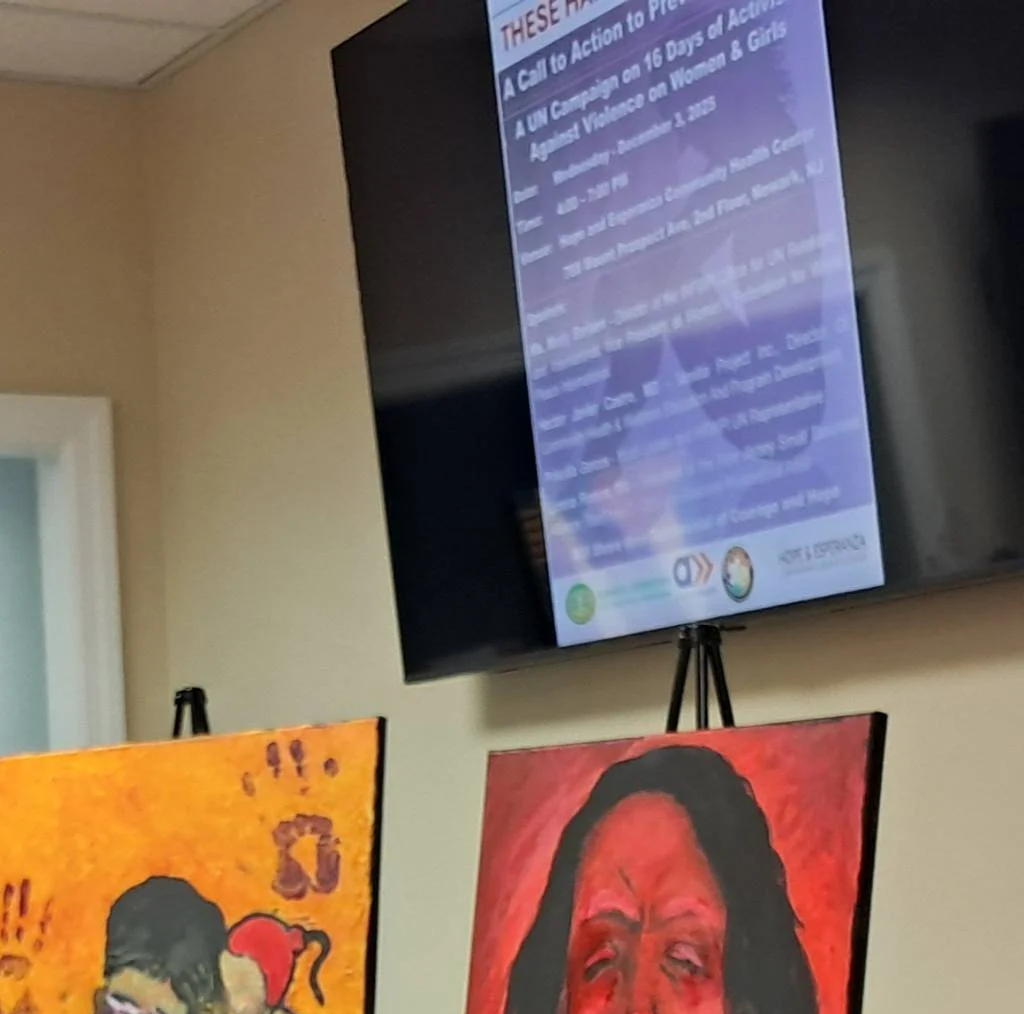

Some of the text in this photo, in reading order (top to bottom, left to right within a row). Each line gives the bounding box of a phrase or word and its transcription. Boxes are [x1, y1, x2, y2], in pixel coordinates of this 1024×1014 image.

[501, 0, 560, 50] THESE
[503, 77, 515, 100] A
[517, 58, 548, 92] Call
[549, 52, 568, 74] to
[571, 22, 623, 64] Action
[626, 10, 645, 33] to
[515, 119, 525, 140] A
[526, 107, 548, 132] UN
[550, 75, 619, 120] Campaign
[622, 64, 641, 84] on
[644, 48, 663, 71] 16
[665, 31, 704, 62] Days
[707, 14, 724, 40] of
[530, 21, 787, 162] Against Violence on Women & Girls
